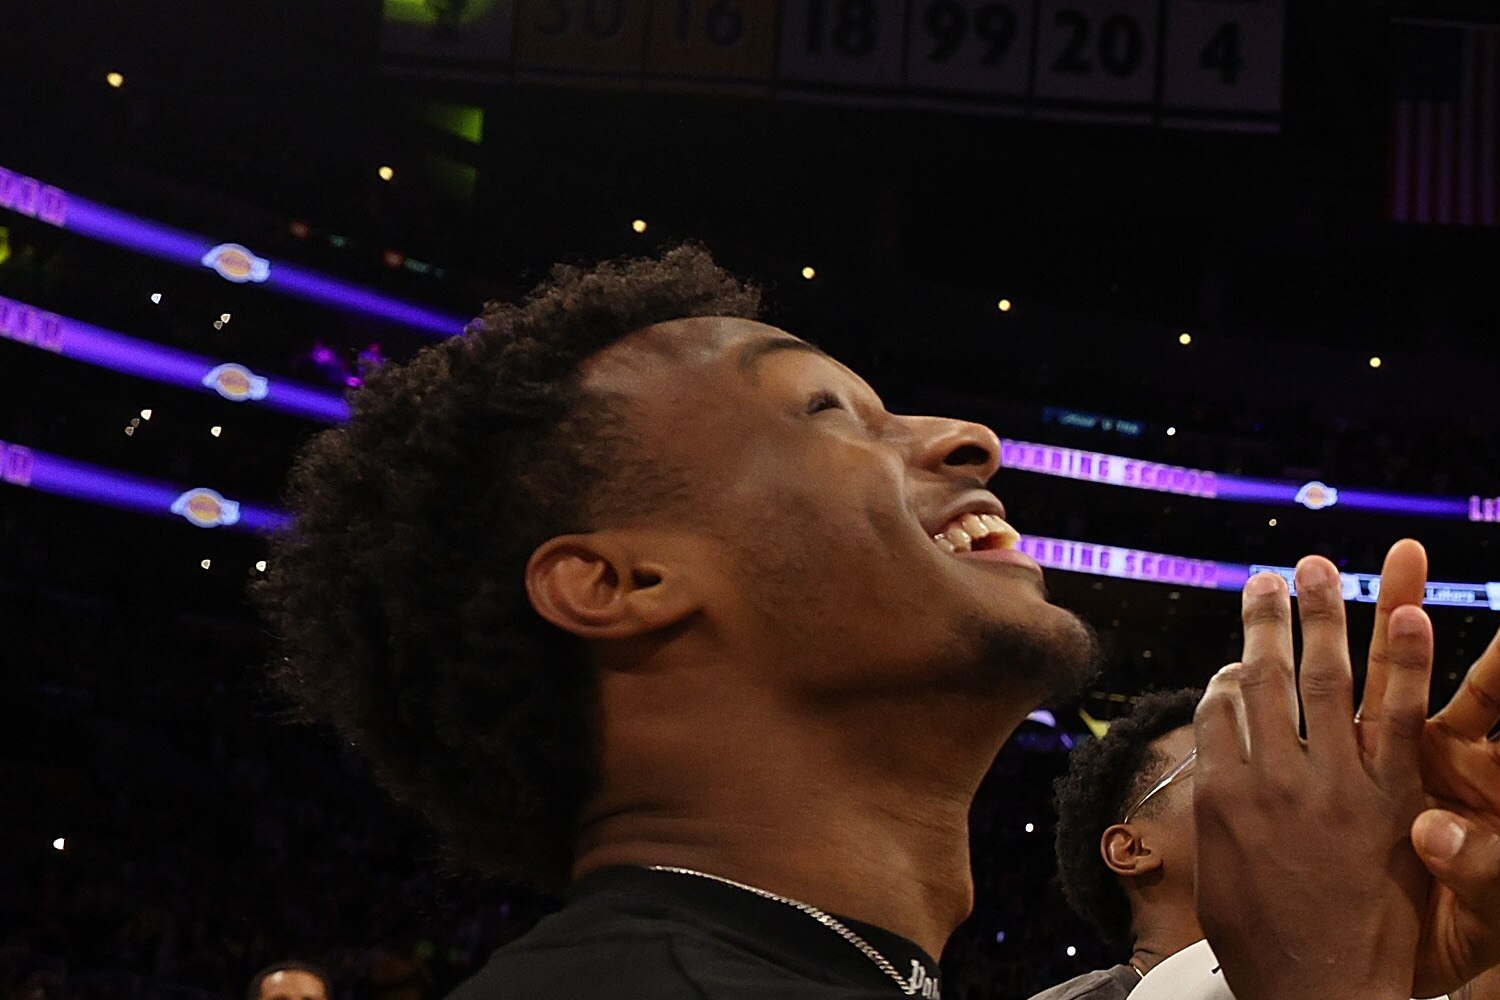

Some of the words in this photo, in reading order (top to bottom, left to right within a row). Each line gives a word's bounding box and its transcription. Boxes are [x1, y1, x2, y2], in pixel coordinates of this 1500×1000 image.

[926, 0, 1018, 66] 99
[1053, 8, 1145, 77] 20
[1200, 19, 1244, 84] 4
